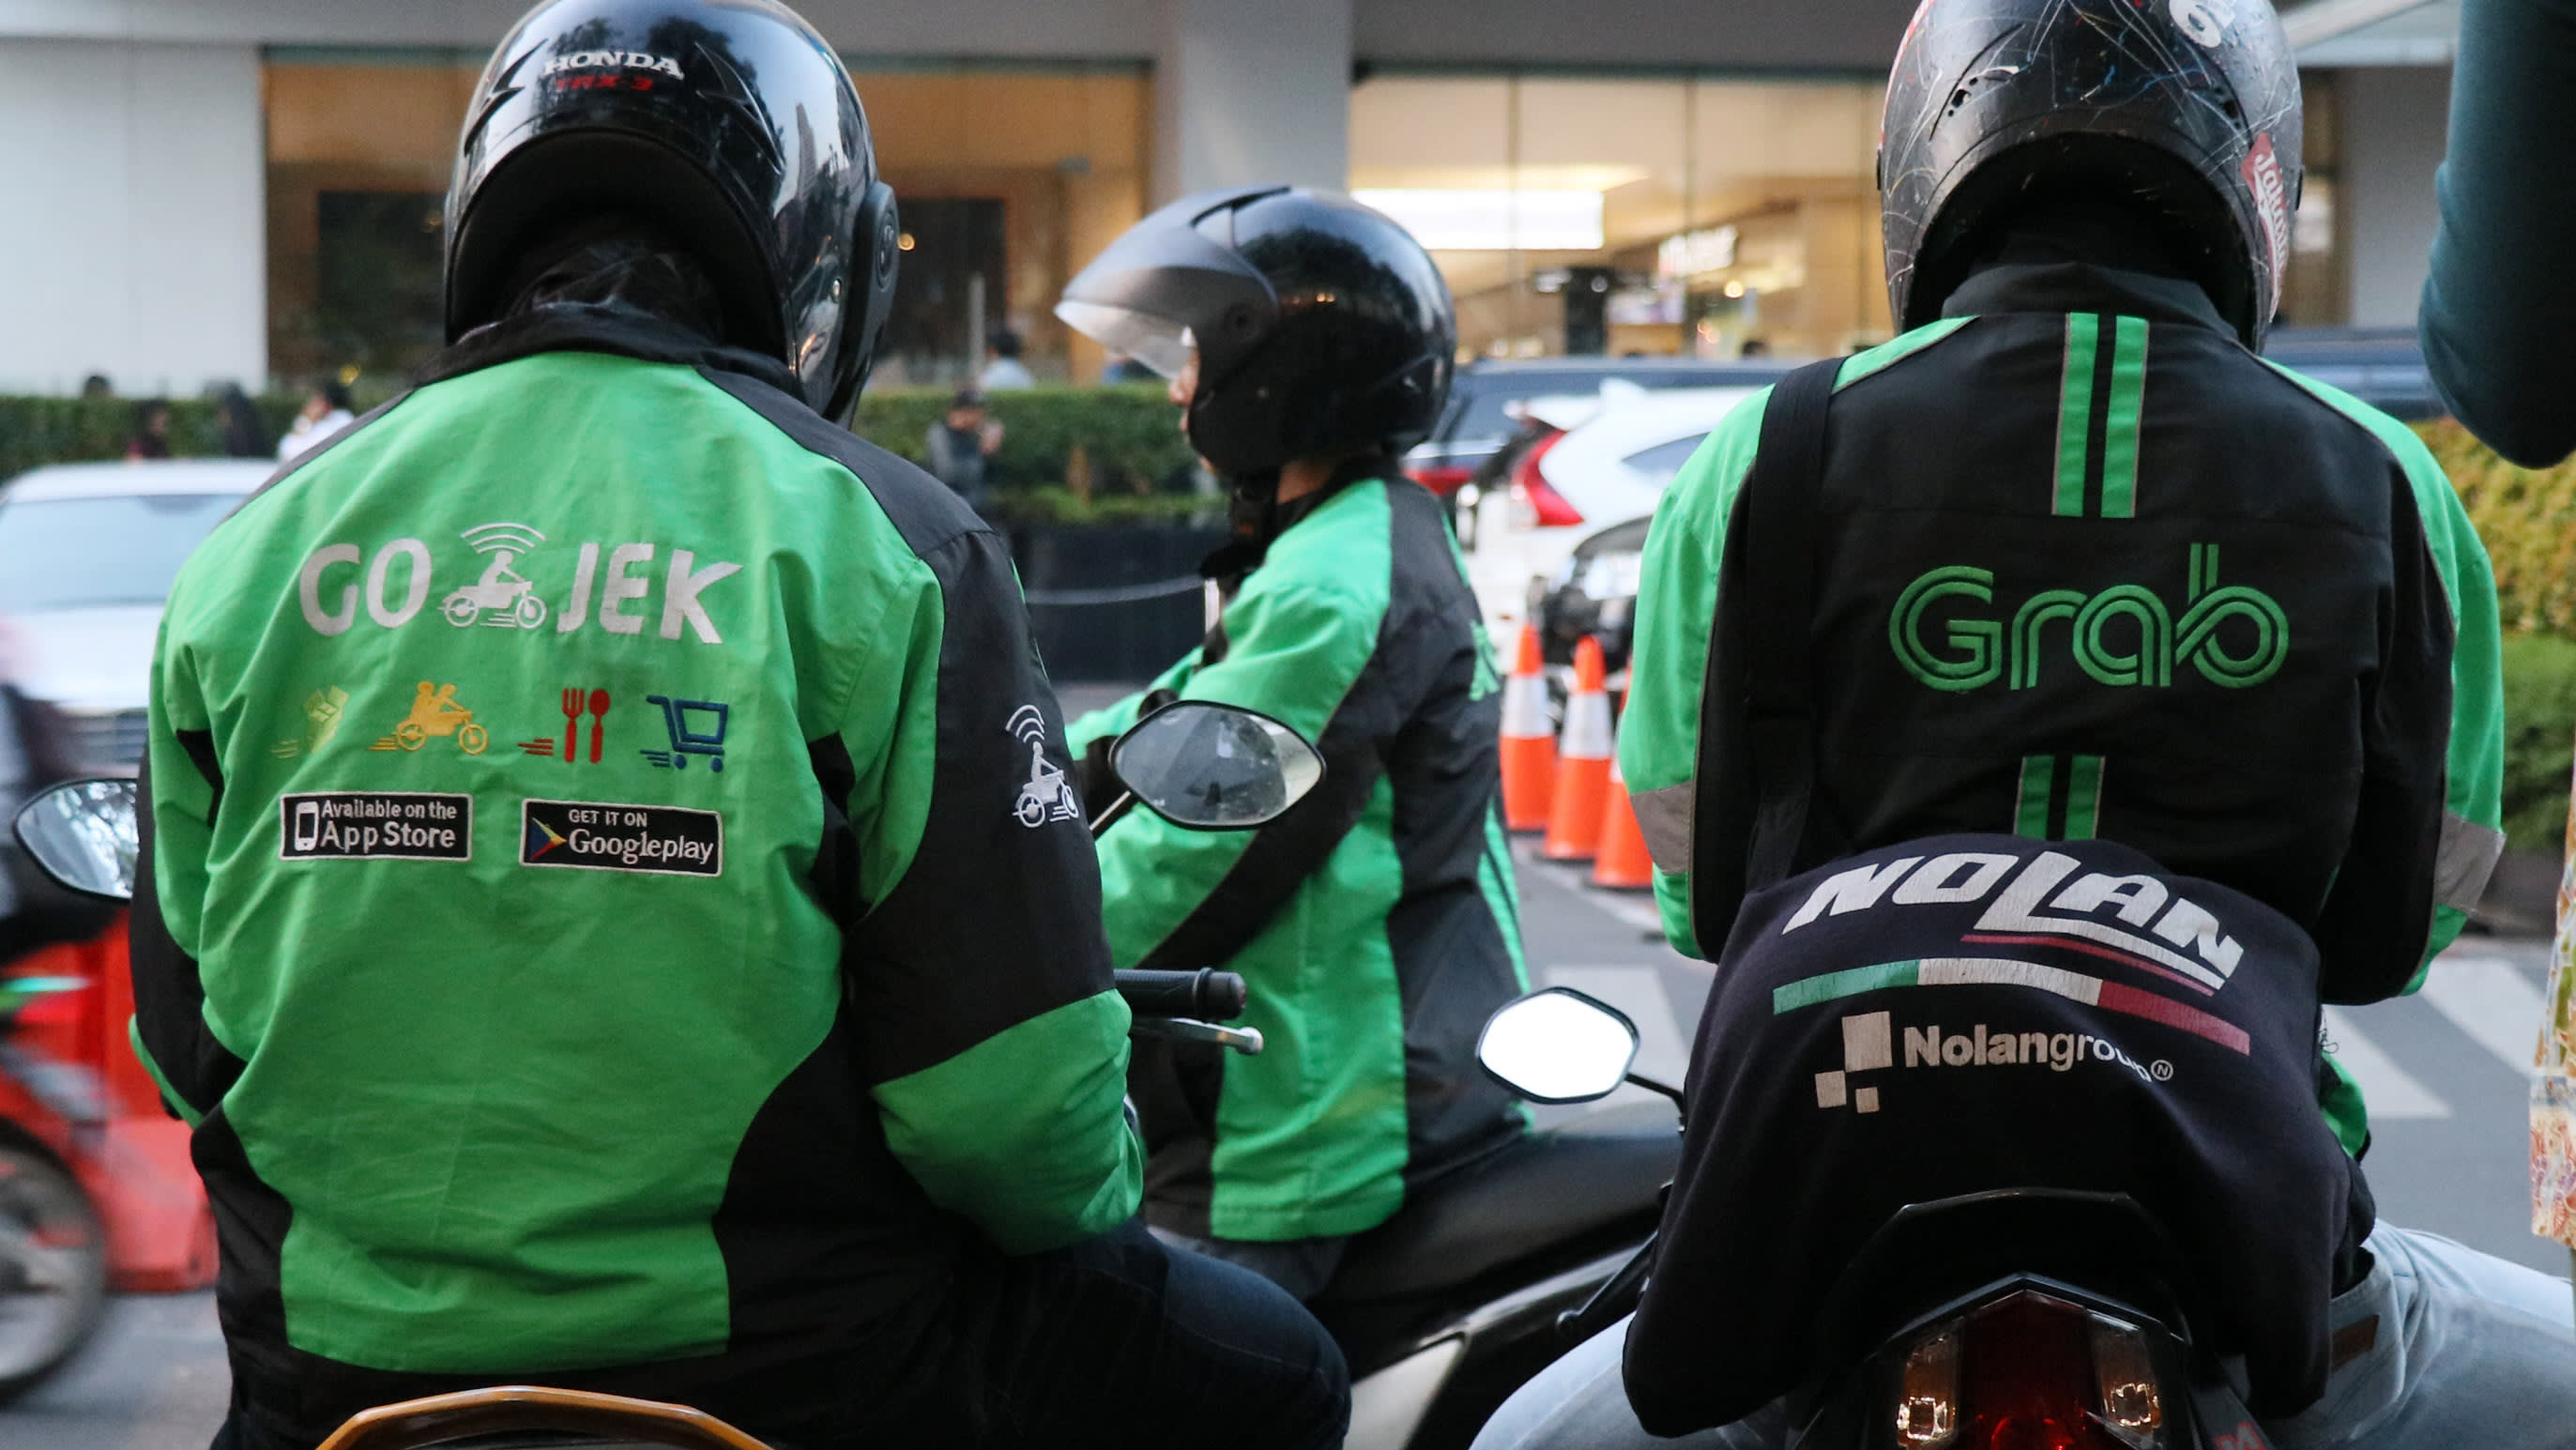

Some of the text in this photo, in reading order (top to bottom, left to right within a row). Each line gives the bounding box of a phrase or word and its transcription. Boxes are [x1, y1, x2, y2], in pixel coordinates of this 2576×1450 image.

[542, 50, 685, 81] HONDA
[299, 538, 743, 644] GO JEK
[1889, 542, 2290, 691] Grab
[321, 800, 458, 819] Available on the
[569, 809, 648, 827] GET IT ON
[320, 820, 456, 853] App Store
[569, 828, 713, 865] Googleplay
[1782, 850, 2245, 990] NOLAN
[1903, 1024, 2153, 1082] Nolangroup
